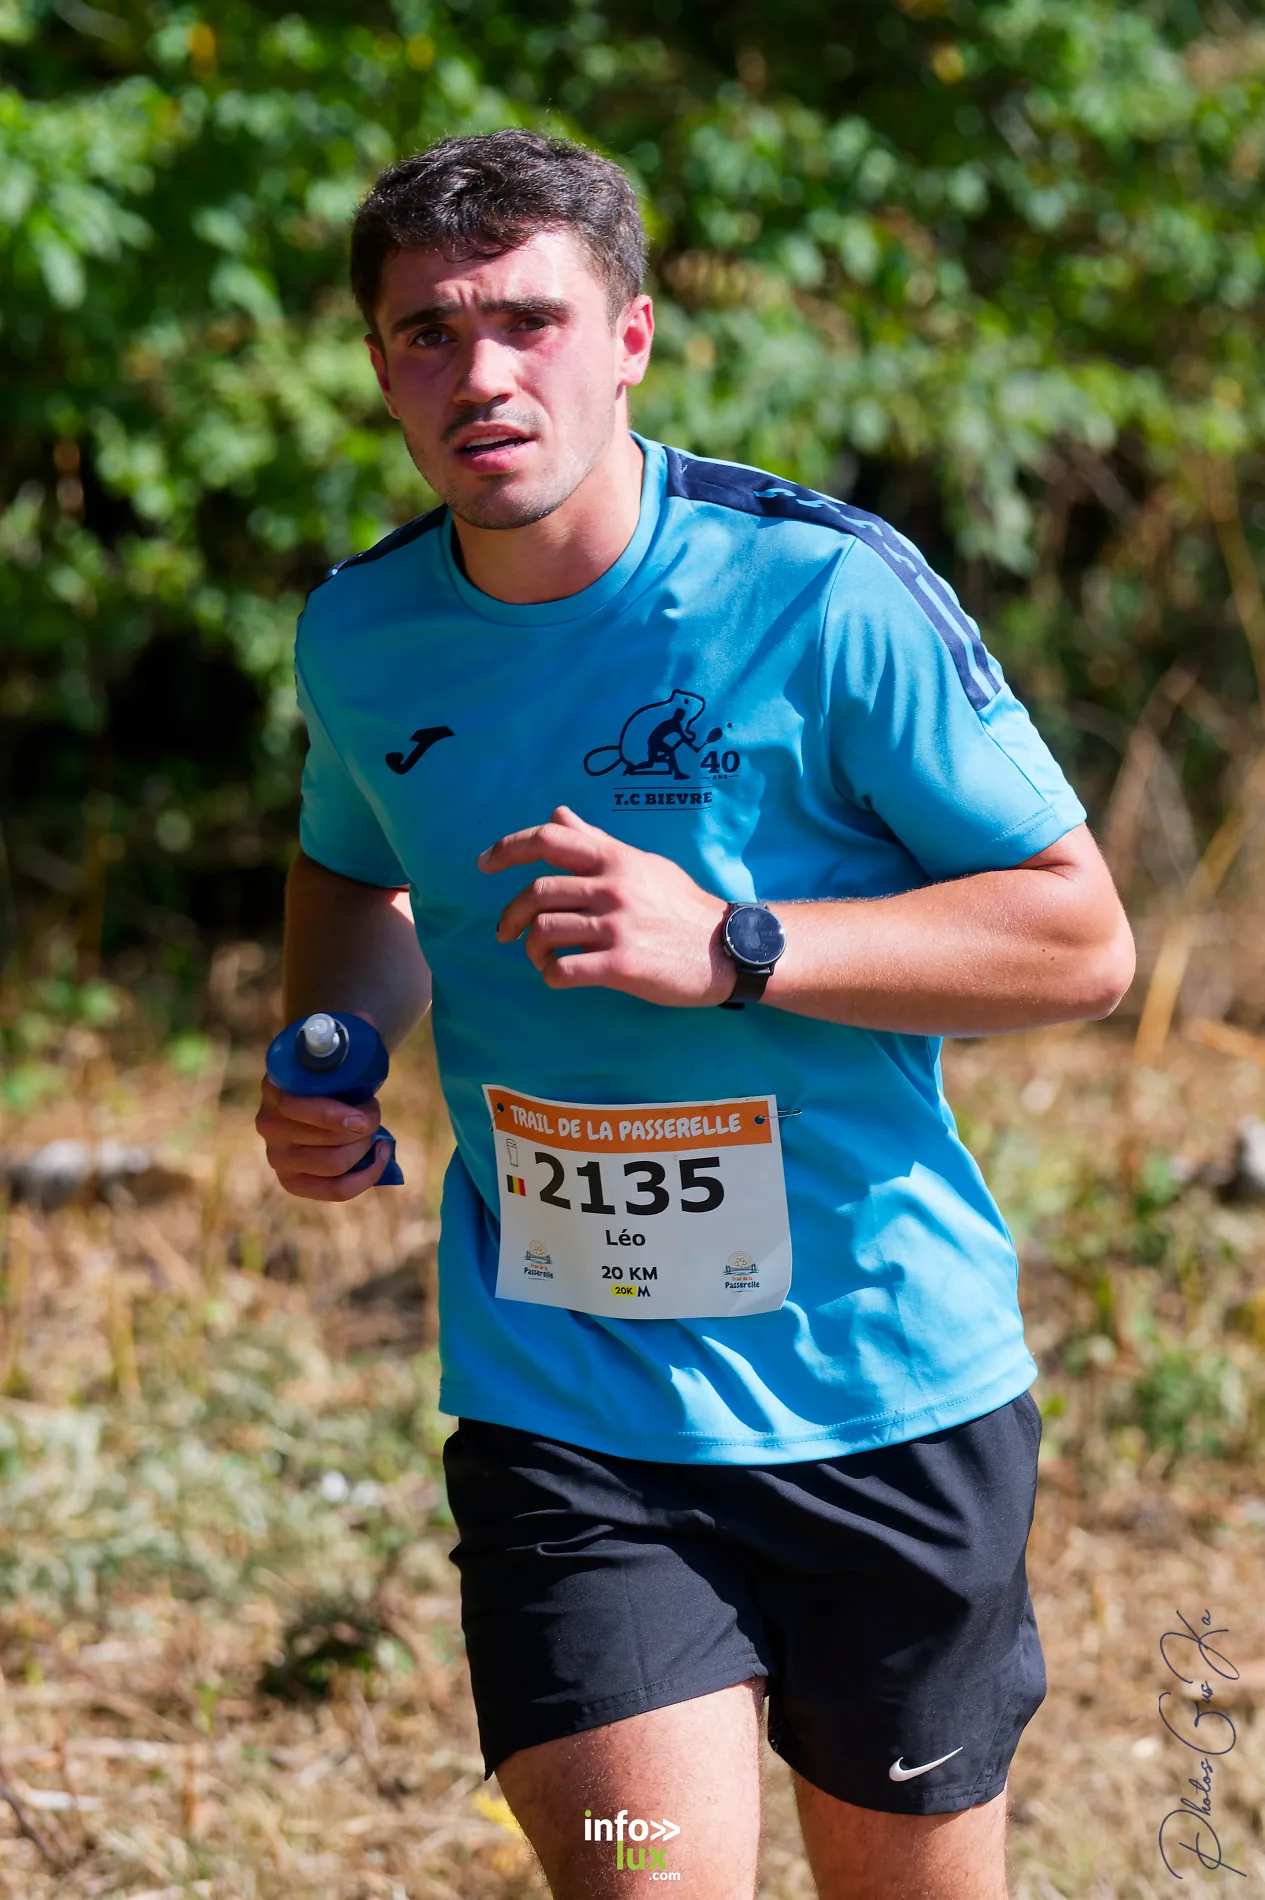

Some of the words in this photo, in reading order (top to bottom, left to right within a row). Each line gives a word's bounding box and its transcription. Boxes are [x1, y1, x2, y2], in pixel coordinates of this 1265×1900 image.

[700, 750, 741, 774] 40
[614, 793, 640, 806] T.C
[645, 791, 713, 806] BIEVRE
[510, 1105, 555, 1135] TRAIL
[558, 1117, 582, 1139] DE
[587, 1120, 614, 1141] LA
[619, 1112, 742, 1142] PASSERELLE
[534, 1151, 725, 1216] 2135
[605, 1228, 646, 1247] Léo
[601, 1265, 624, 1280] 20
[629, 1266, 658, 1281] KM
[615, 1286, 633, 1295] 20K
[724, 1281, 760, 1289] Passerelle
